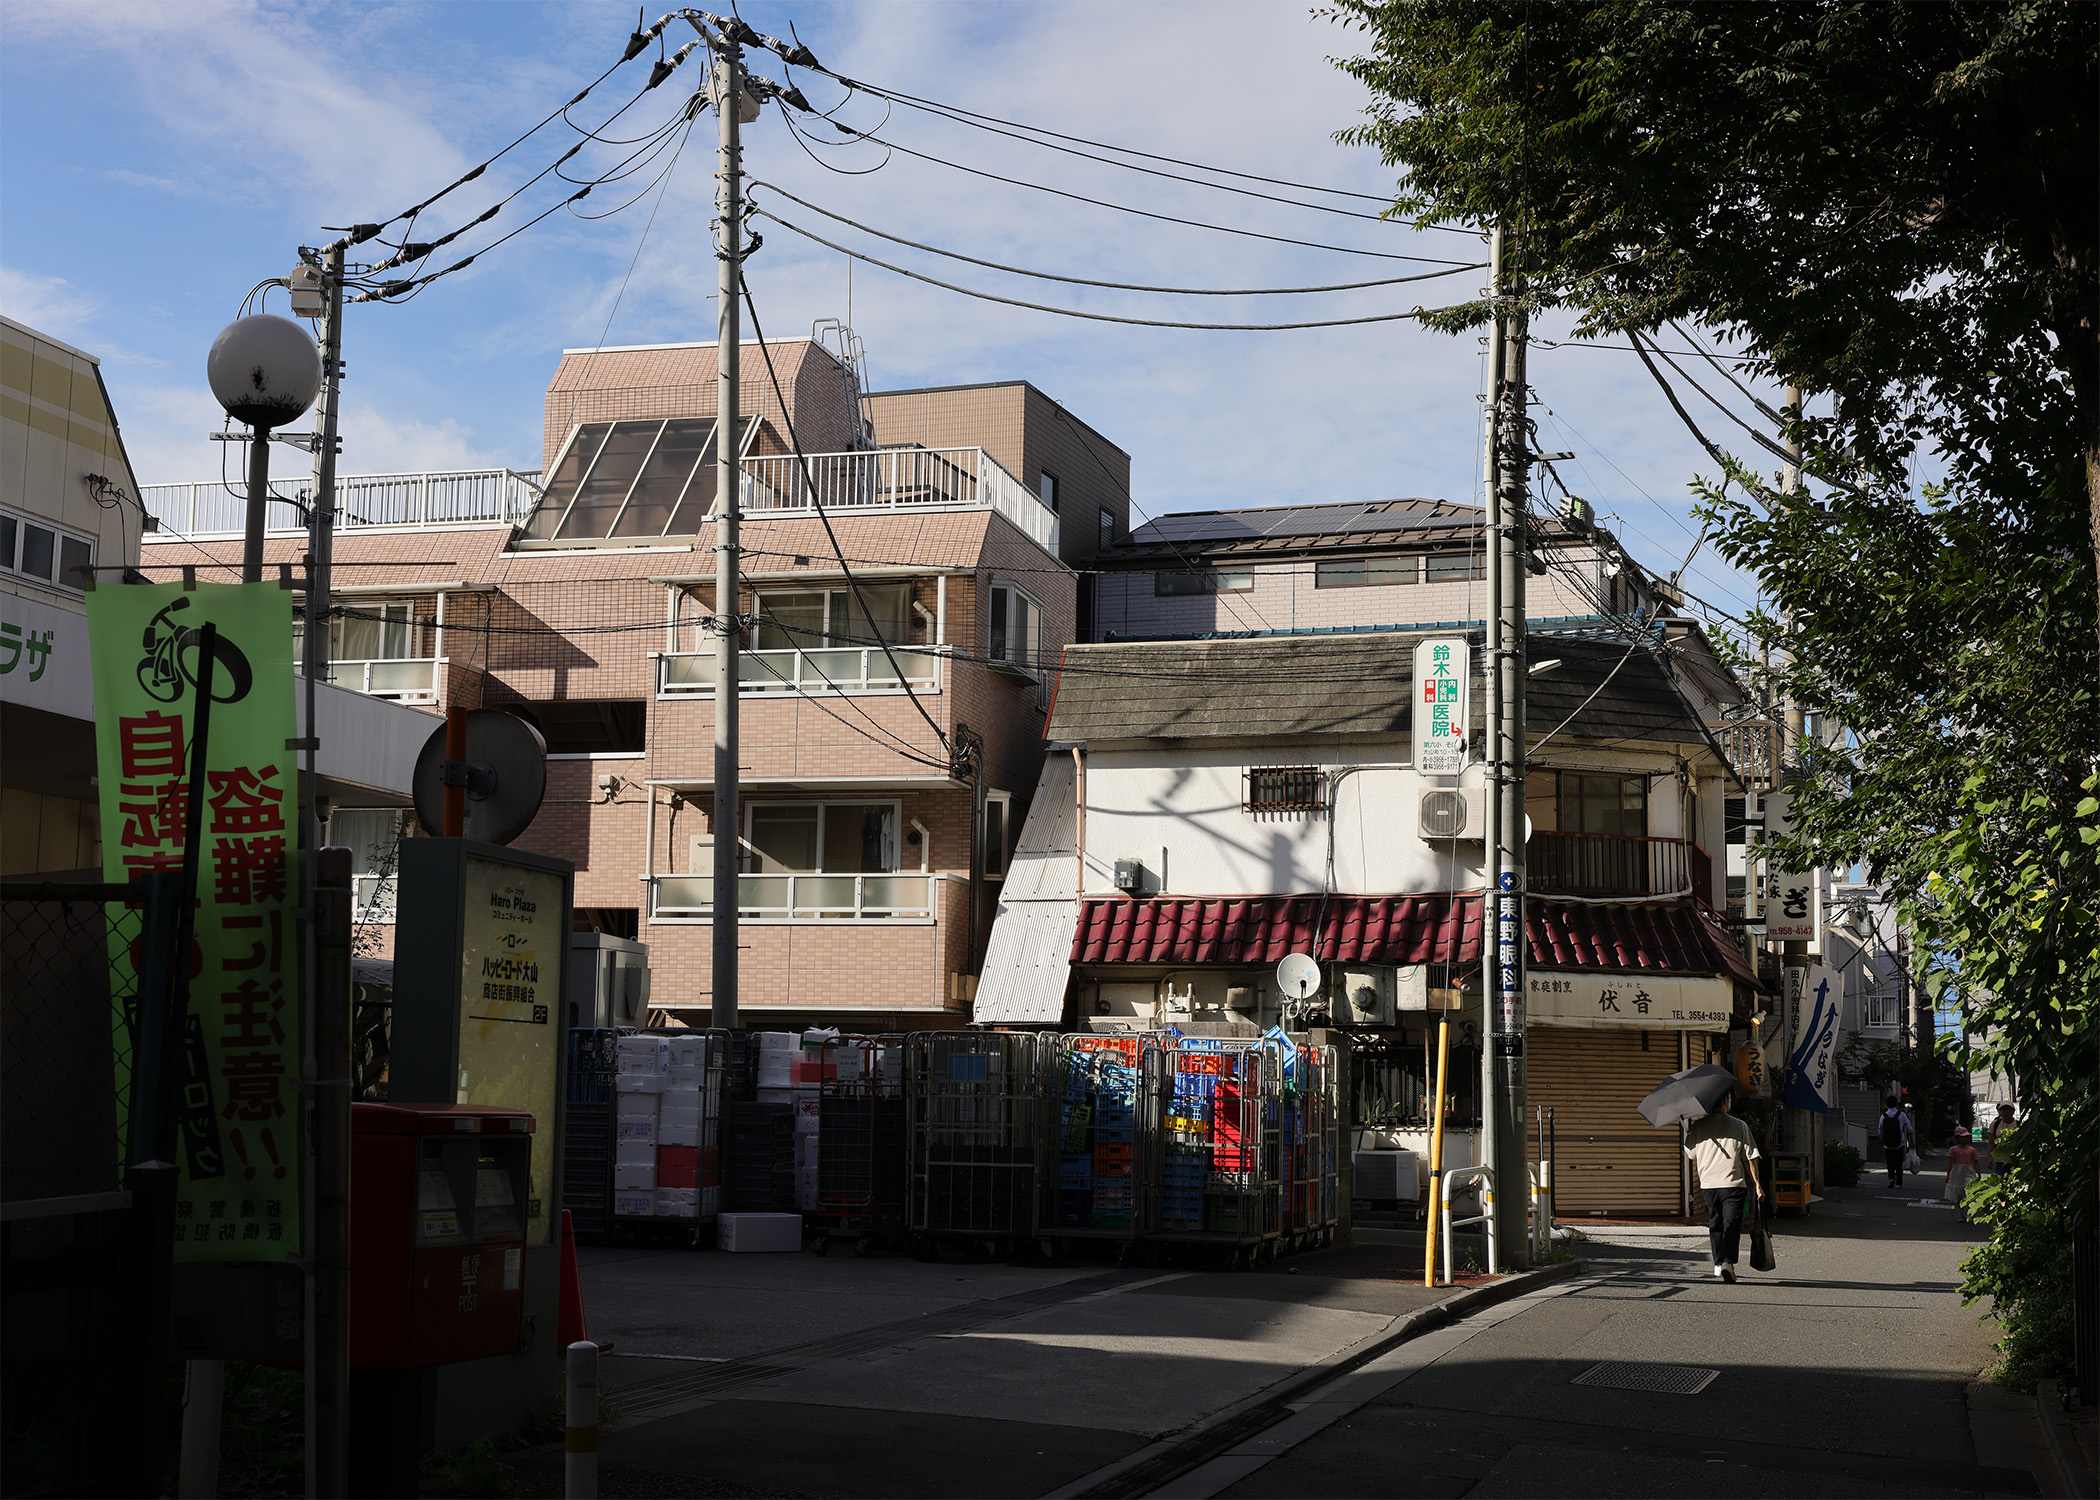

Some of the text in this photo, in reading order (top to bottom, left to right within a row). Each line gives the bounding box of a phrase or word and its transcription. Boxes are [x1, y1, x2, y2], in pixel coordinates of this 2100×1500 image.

[0, 621, 54, 683] ラザ
[1432, 644, 1451, 678] 鈴木
[1426, 680, 1434, 702] 歯科
[1440, 680, 1448, 702] 小児科
[1448, 680, 1456, 702] 内科
[1432, 704, 1450, 737] 医院
[490, 892, 536, 913] Haro Plaza
[1498, 896, 1519, 990] 東野眼科
[483, 982, 535, 1004] 商店街振興組合
[1598, 988, 1653, 1015] 伏音
[534, 1007, 547, 1022] 2F
[1672, 1010, 1726, 1021] TEL 3554-4393
[1747, 1047, 1762, 1086] うなぎ
[1814, 1030, 1833, 1089] うなぎ
[460, 1255, 481, 1277] 郵便
[458, 1294, 479, 1313] POST
